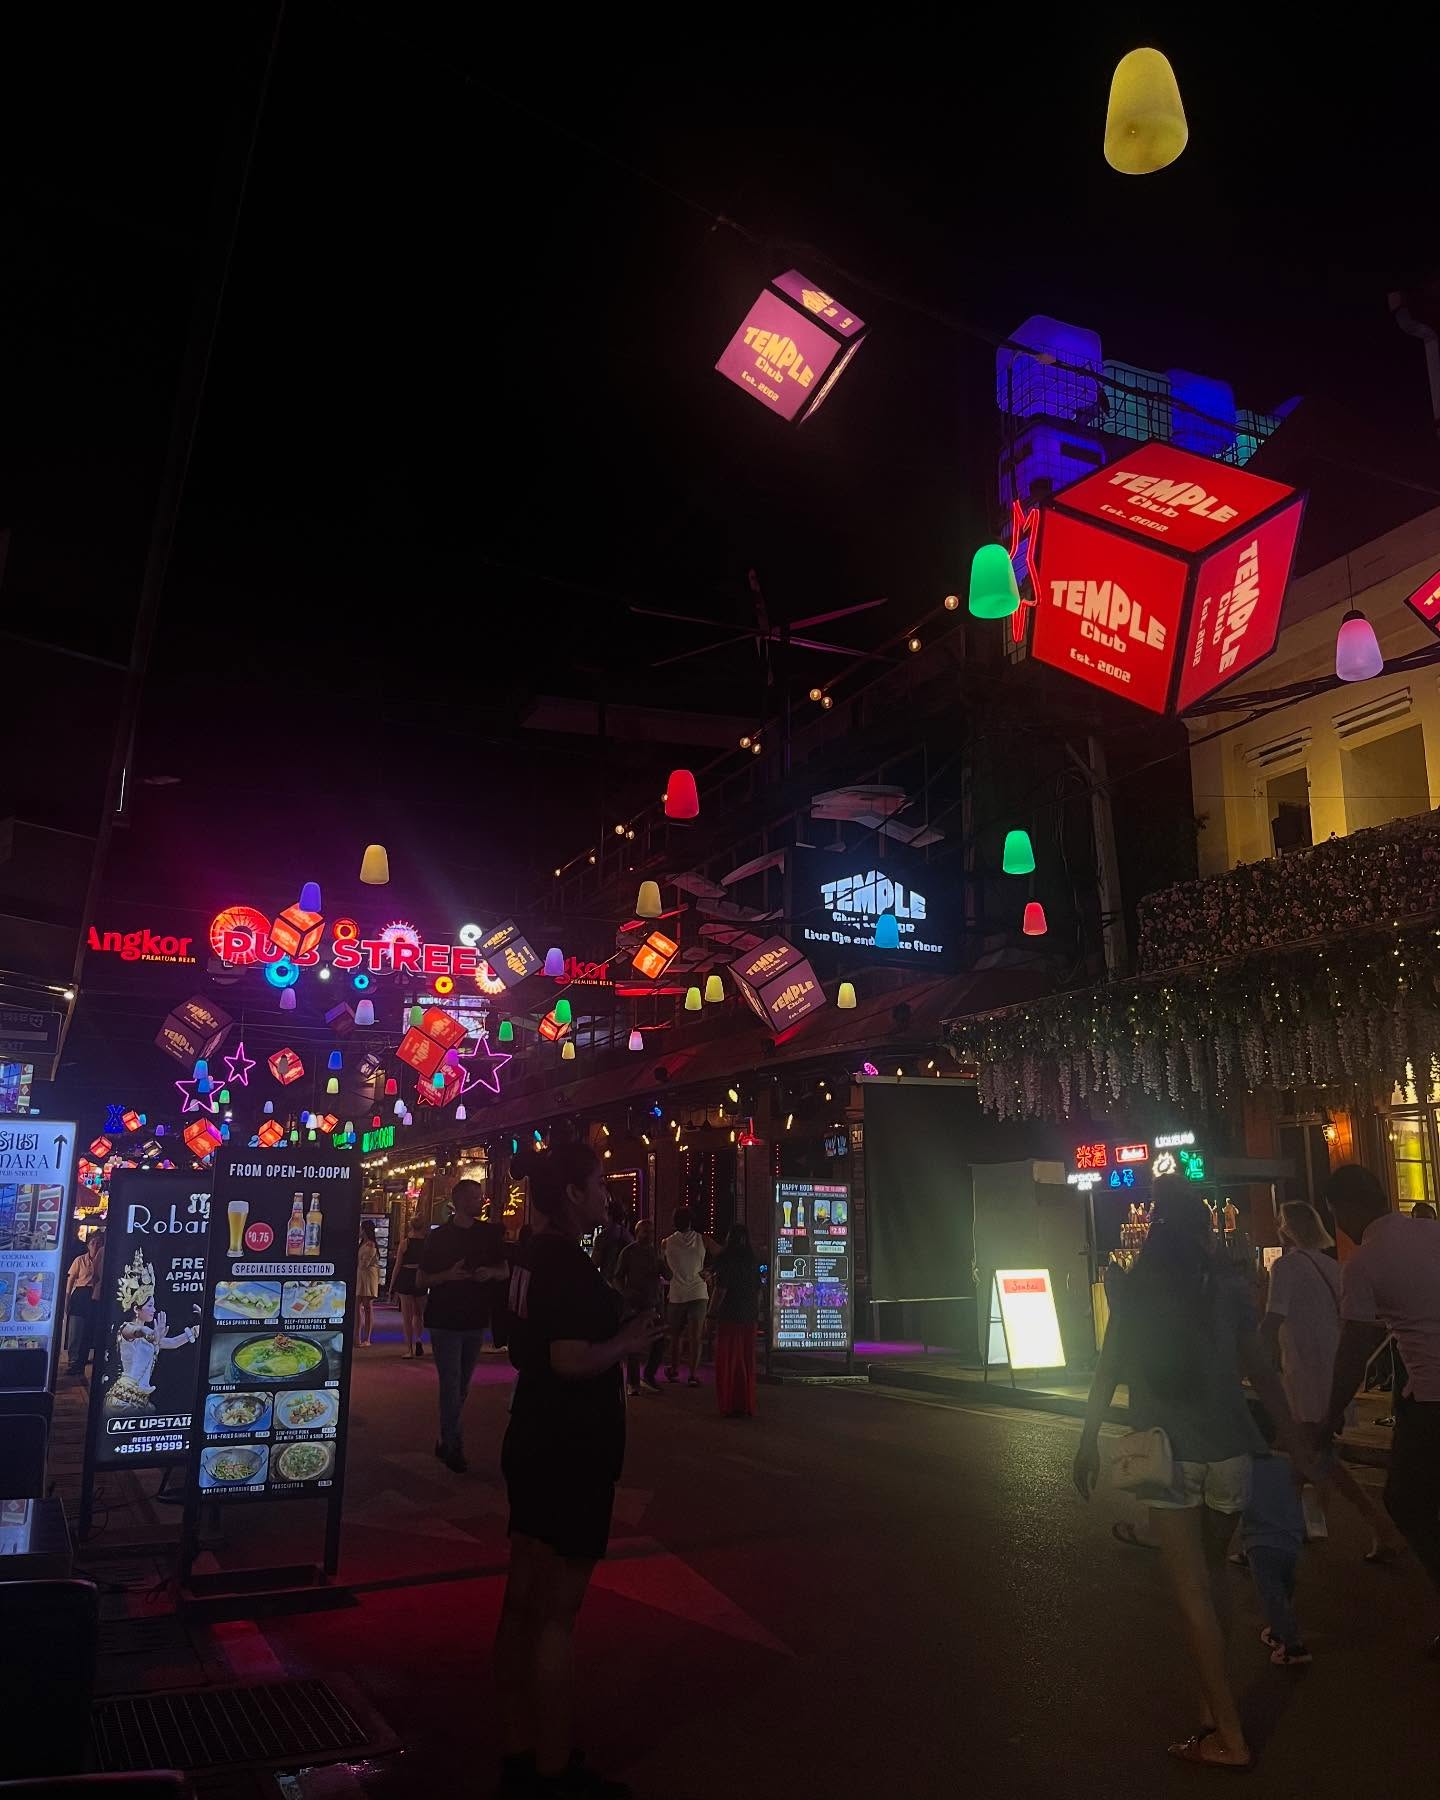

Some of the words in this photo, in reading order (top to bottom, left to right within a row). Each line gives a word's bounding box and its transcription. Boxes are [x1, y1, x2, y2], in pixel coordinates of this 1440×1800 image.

[743, 326, 814, 388] TEMPLE
[755, 355, 784, 384] Club
[741, 370, 758, 387] Est.
[758, 382, 780, 402] 2002
[1108, 471, 1239, 524] TEMPLE
[1127, 494, 1180, 519] Club
[1099, 504, 1127, 519] Est.
[1129, 515, 1169, 532] 2002
[1050, 580, 1167, 651] TEMPLE
[1200, 597, 1212, 627] Est.
[1212, 591, 1232, 645] Club
[1218, 539, 1260, 673] TEMPLE
[1080, 620, 1127, 653] Club
[1192, 628, 1206, 668] 2002
[1070, 648, 1096, 669] Est.
[1097, 659, 1131, 684] 2002
[820, 870, 927, 920] TEMPLE
[88, 926, 192, 961] Angkor
[804, 929, 830, 942] Live
[141, 954, 177, 962] PREMIUM
[332, 938, 496, 977] STREE
[746, 946, 789, 976] TEMPLE
[772, 980, 815, 1013] TEMPLE
[187, 1003, 219, 1029] TEMPLE
[164, 1029, 195, 1055] TEMPLE
[229, 1164, 262, 1177] FROM
[266, 1165, 350, 1179] OPEN-10:00PM
[782, 1183, 798, 1191] HAPPY
[248, 1232, 269, 1242] $0.75
[235, 1265, 286, 1274] SPECIALTIES
[288, 1265, 331, 1274] SELECTION
[112, 1420, 136, 1431] A/C
[132, 1434, 183, 1443] RESERVATION
[114, 1443, 152, 1453] +85515
[155, 1441, 182, 1451] 9999
